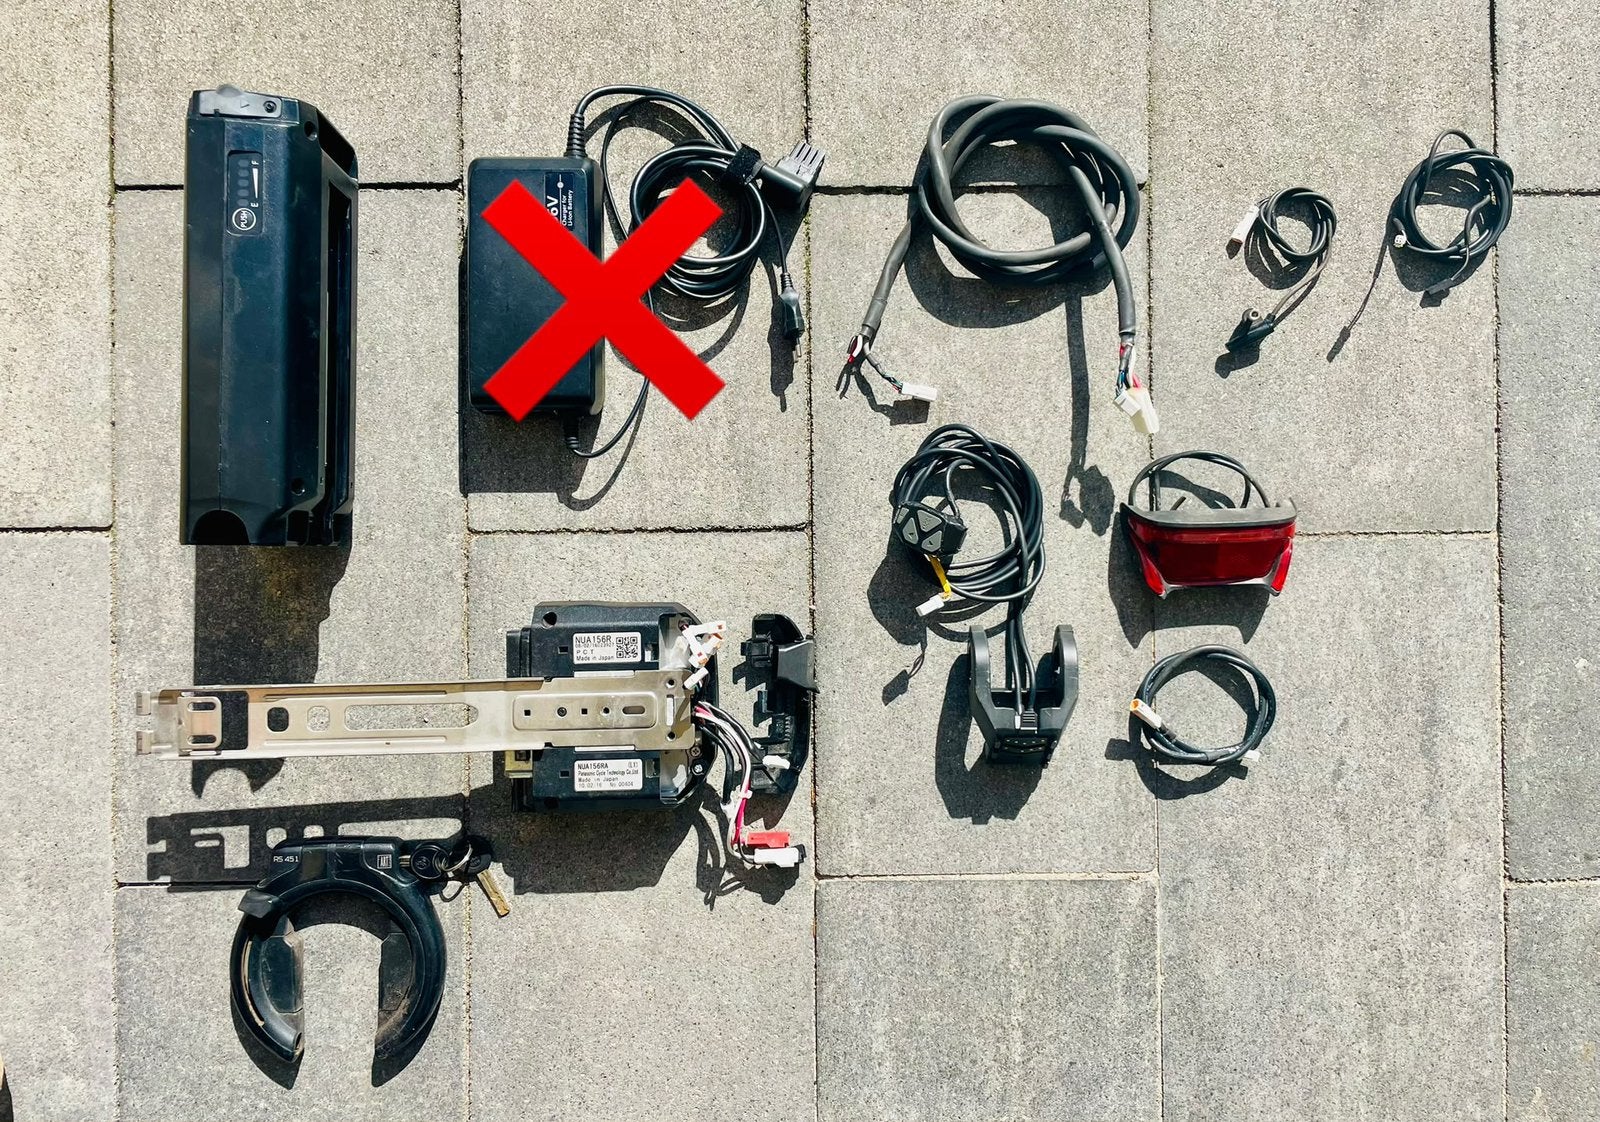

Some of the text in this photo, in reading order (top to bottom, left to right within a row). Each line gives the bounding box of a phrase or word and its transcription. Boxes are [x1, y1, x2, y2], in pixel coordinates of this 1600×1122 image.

[546, 195, 559, 222] 6V
[240, 210, 248, 228] PUSH
[575, 635, 612, 644] NUA156R
